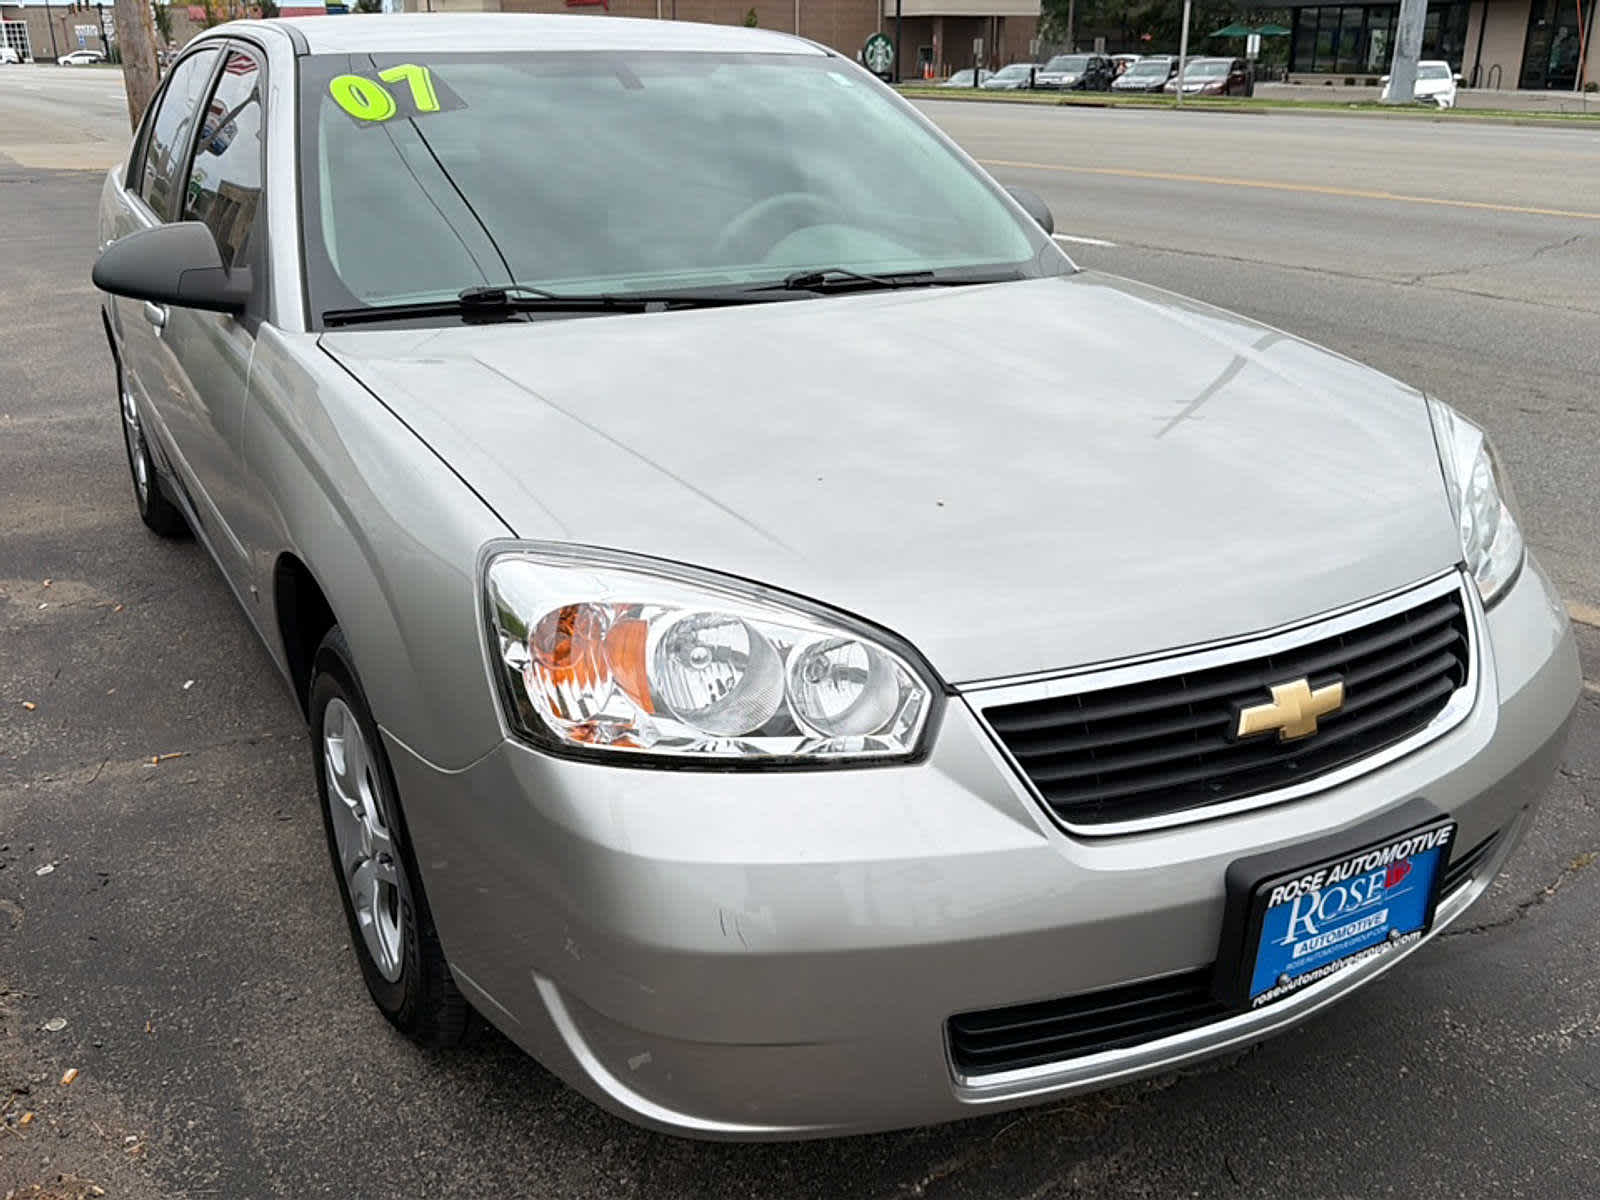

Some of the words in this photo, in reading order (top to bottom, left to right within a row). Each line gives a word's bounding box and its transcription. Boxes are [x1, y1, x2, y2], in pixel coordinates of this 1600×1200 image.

[329, 63, 441, 121] 07
[1268, 870, 1329, 908] ROSE
[1325, 825, 1454, 887] AUTOMOTIVE
[1280, 869, 1388, 946] ROSE
[1298, 914, 1383, 955] AUTOMOTIVE
